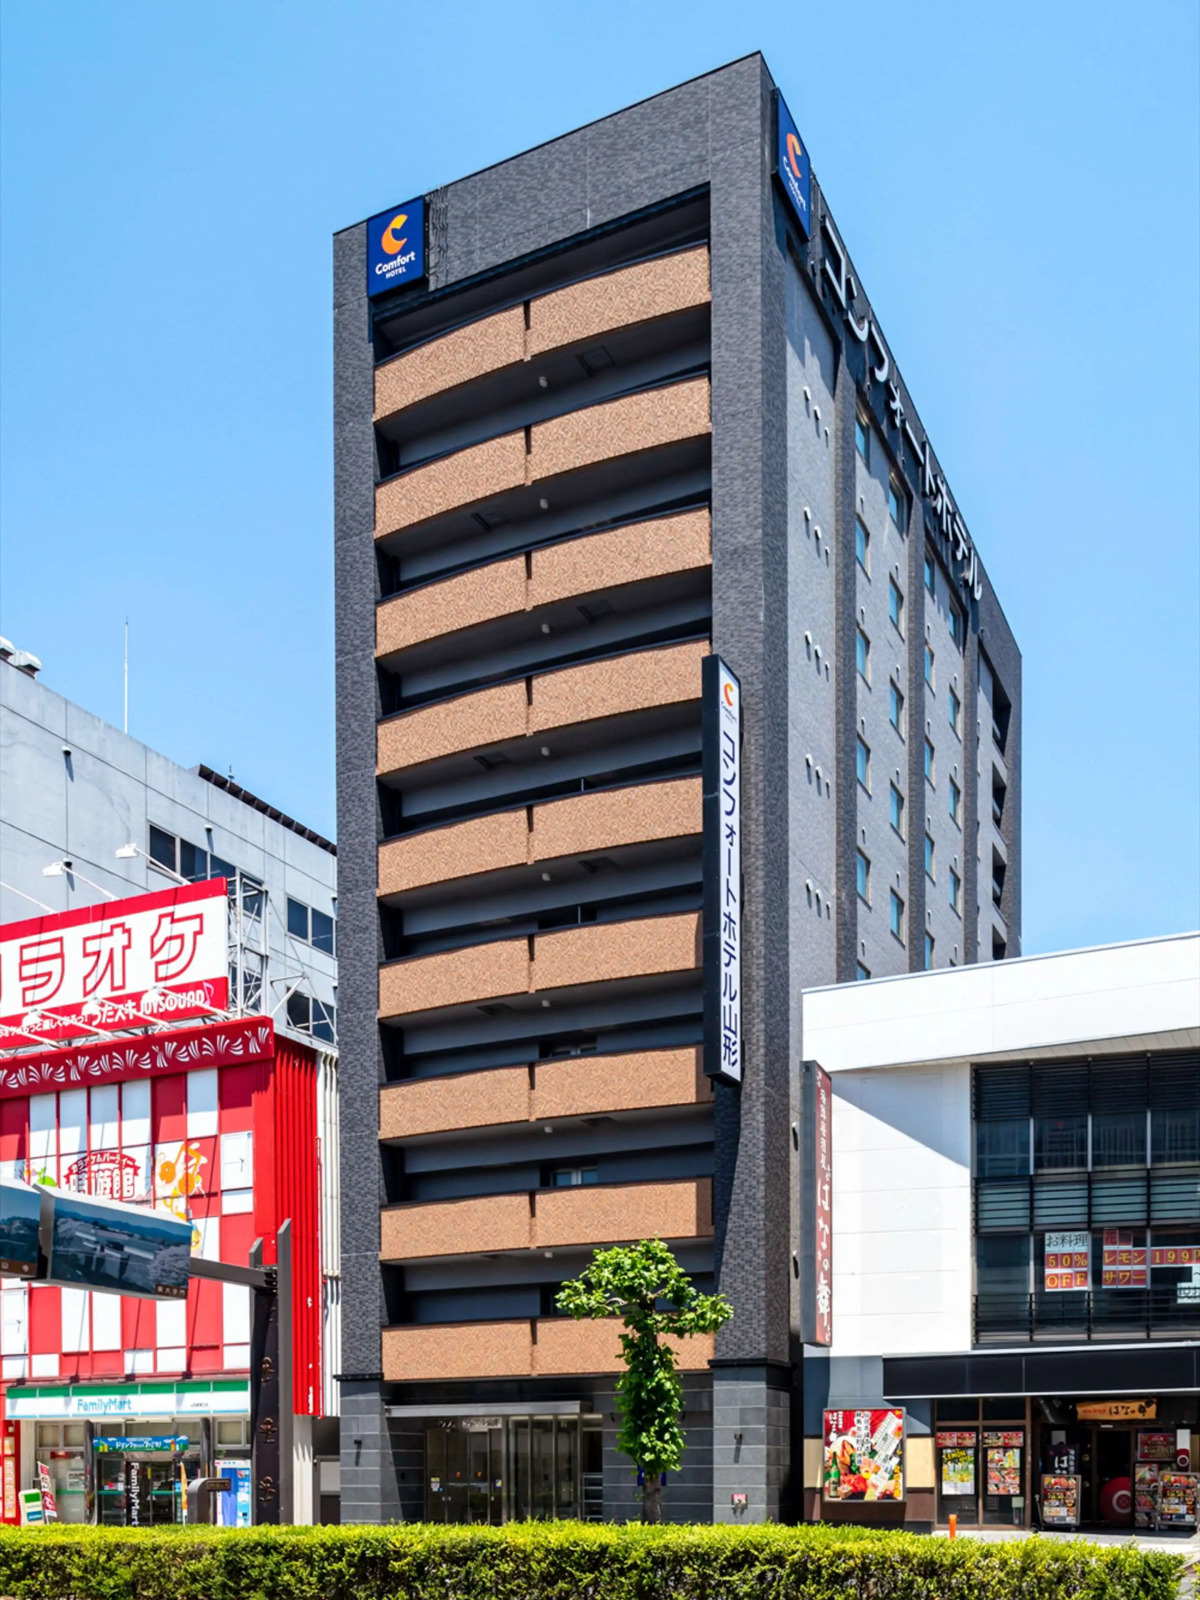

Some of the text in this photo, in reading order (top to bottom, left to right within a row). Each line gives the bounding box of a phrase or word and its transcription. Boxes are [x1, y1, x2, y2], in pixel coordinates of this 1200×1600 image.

[375, 251, 416, 275] Comfort
[385, 266, 407, 279] HOTEL
[825, 217, 982, 601] コンフォートホテル
[722, 730, 739, 1067] コンフォートホテル山形
[1046, 1234, 1087, 1247] お料理
[1048, 1254, 1087, 1267] 50%
[1104, 1252, 1145, 1265] レモン
[1046, 1273, 1086, 1287] OFF
[1104, 1272, 1145, 1284] サワー
[77, 1398, 132, 1414] FamilyMart
[129, 1462, 140, 1526] FamilyMart
